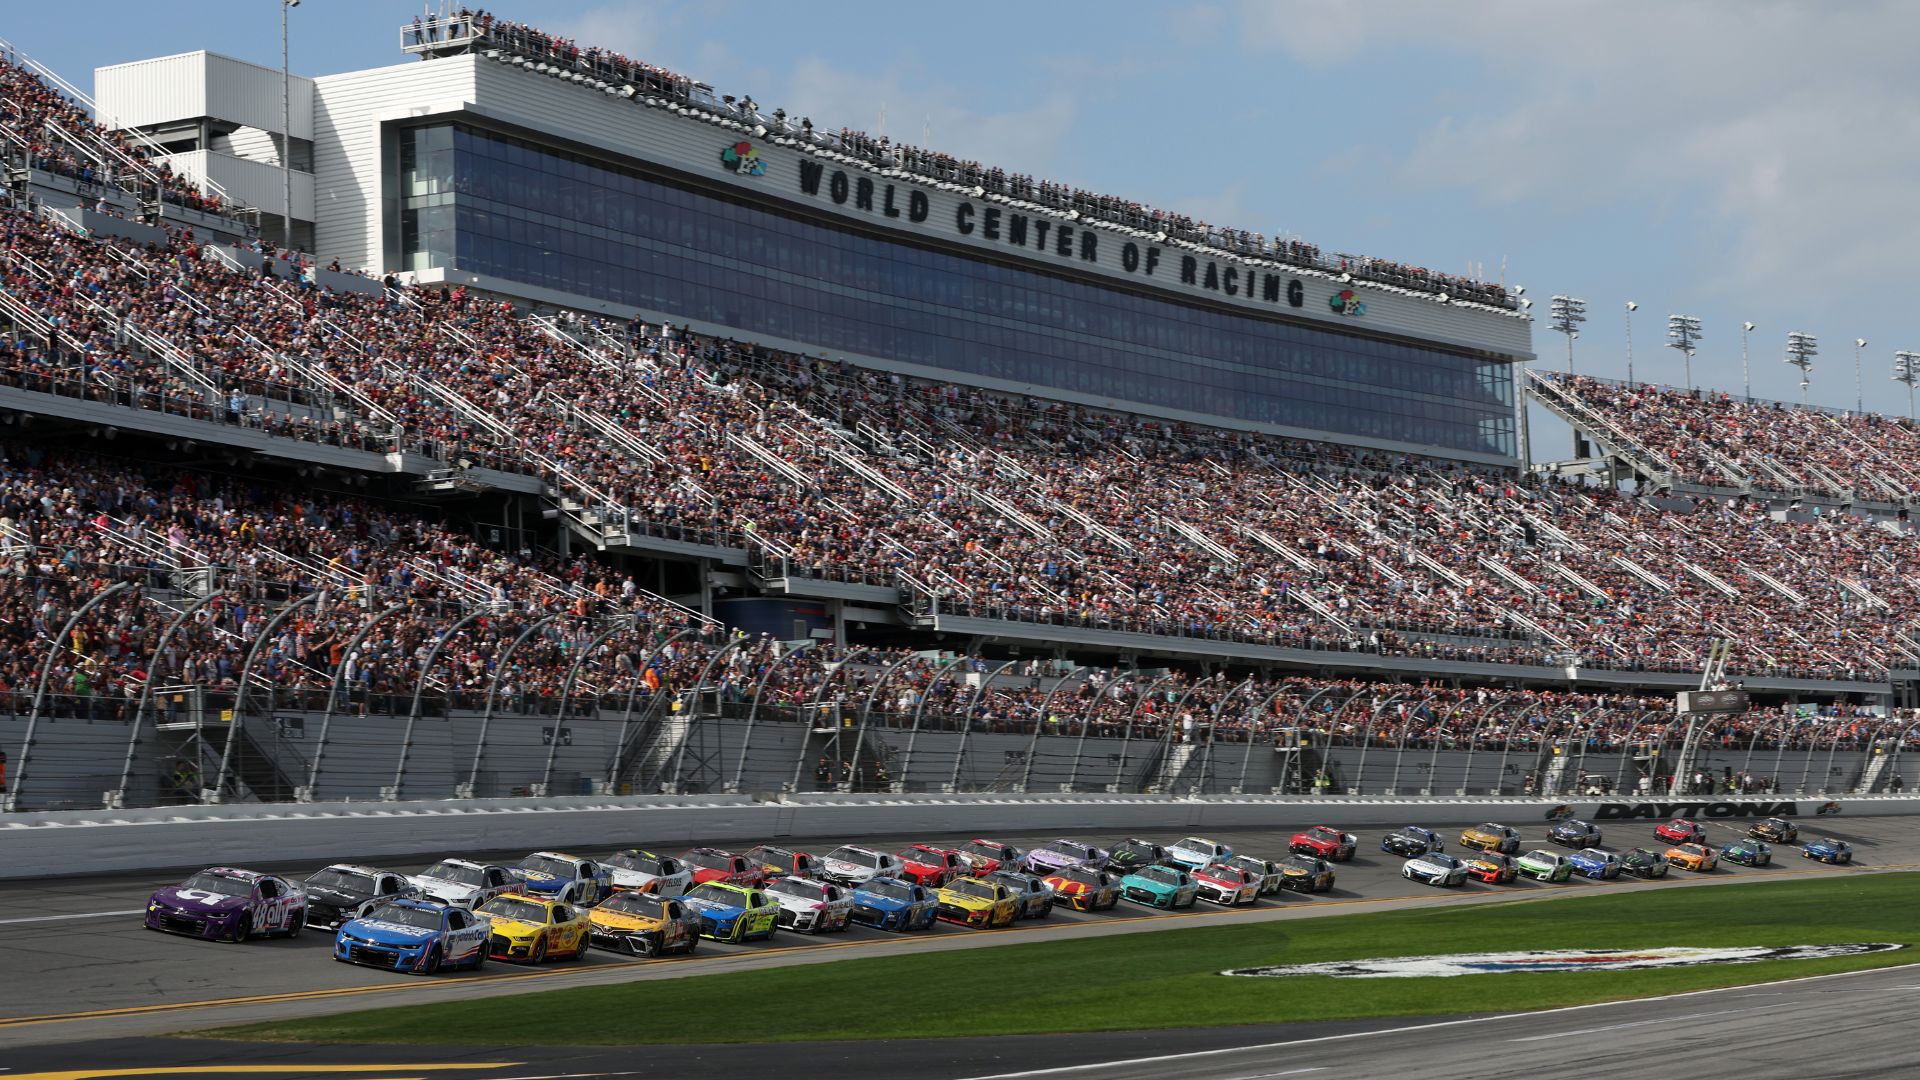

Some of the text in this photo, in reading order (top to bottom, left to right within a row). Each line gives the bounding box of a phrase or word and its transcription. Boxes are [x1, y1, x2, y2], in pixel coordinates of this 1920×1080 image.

[799, 158, 1304, 308] WORLD CENTER OF RACING
[1593, 802, 1798, 819] DAYTONA
[252, 899, 289, 928] 48 ally
